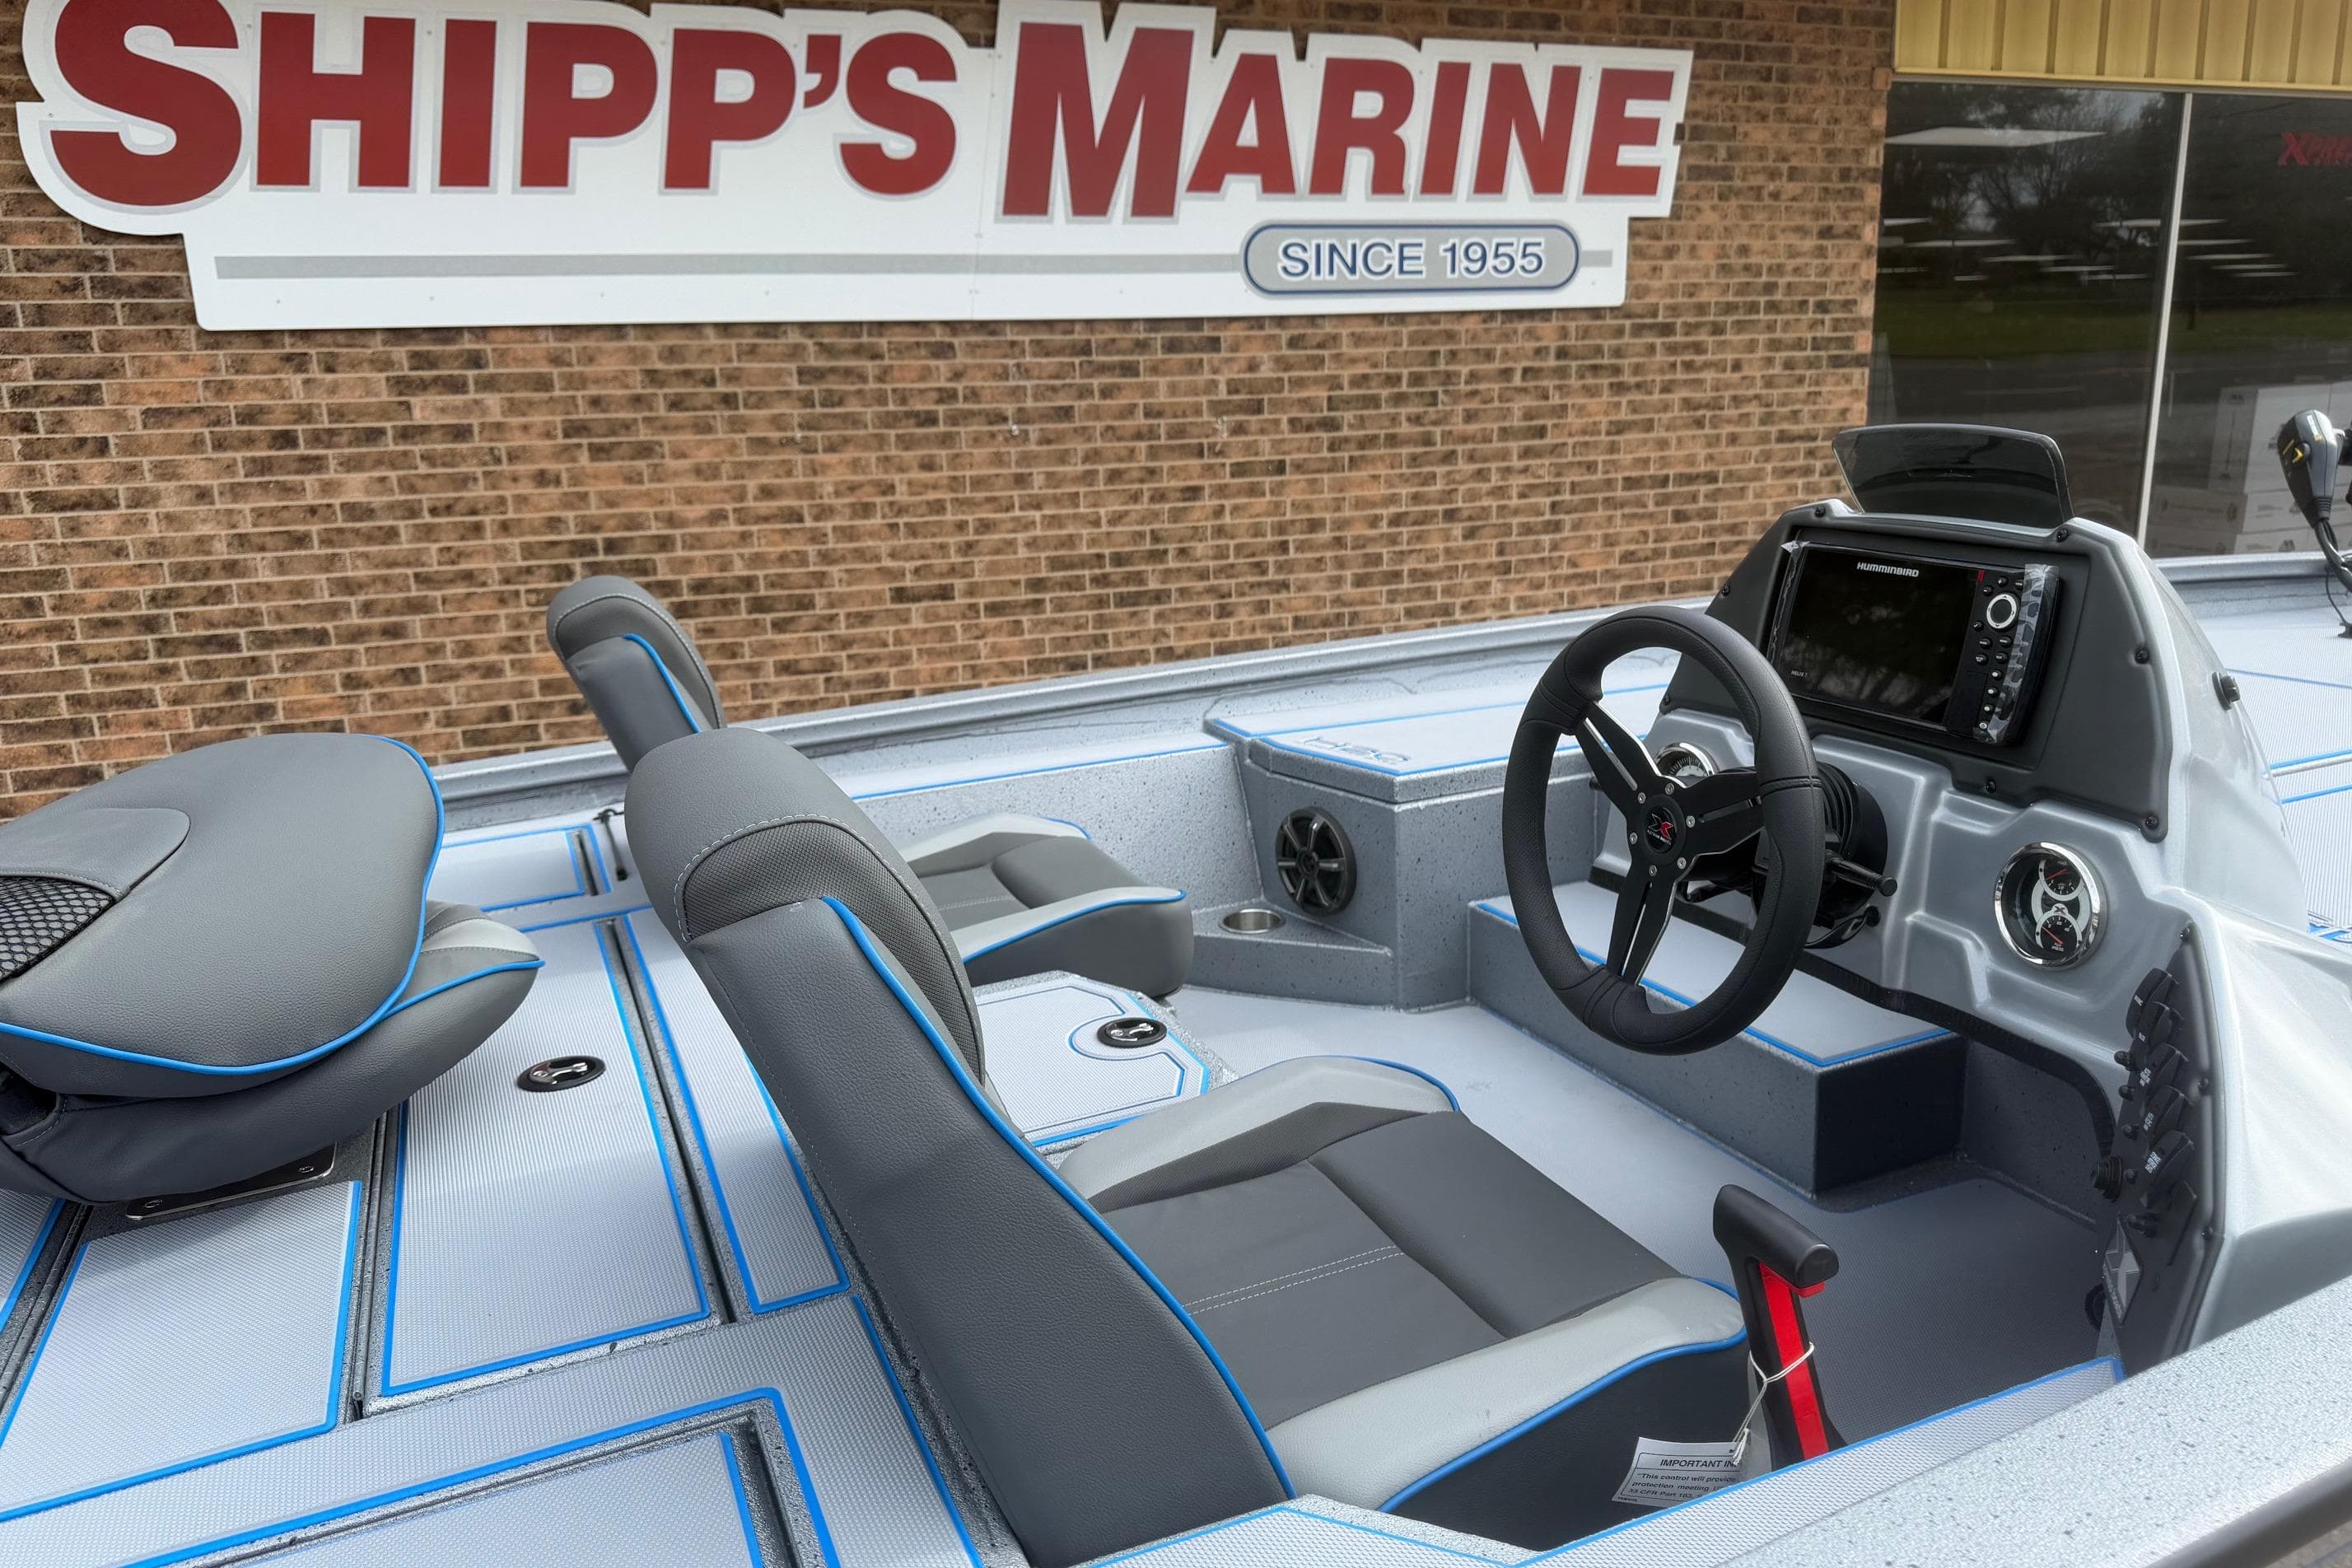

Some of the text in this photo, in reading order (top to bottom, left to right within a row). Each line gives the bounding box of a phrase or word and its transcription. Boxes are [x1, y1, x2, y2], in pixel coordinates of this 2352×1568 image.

[51, 0, 1675, 217] SHIPP'S MARINE
[1281, 240, 1544, 278] SINCE 1955
[1856, 562, 1920, 577] HUMMINBIRD
[1659, 1458, 1723, 1468] IMPORTANT
